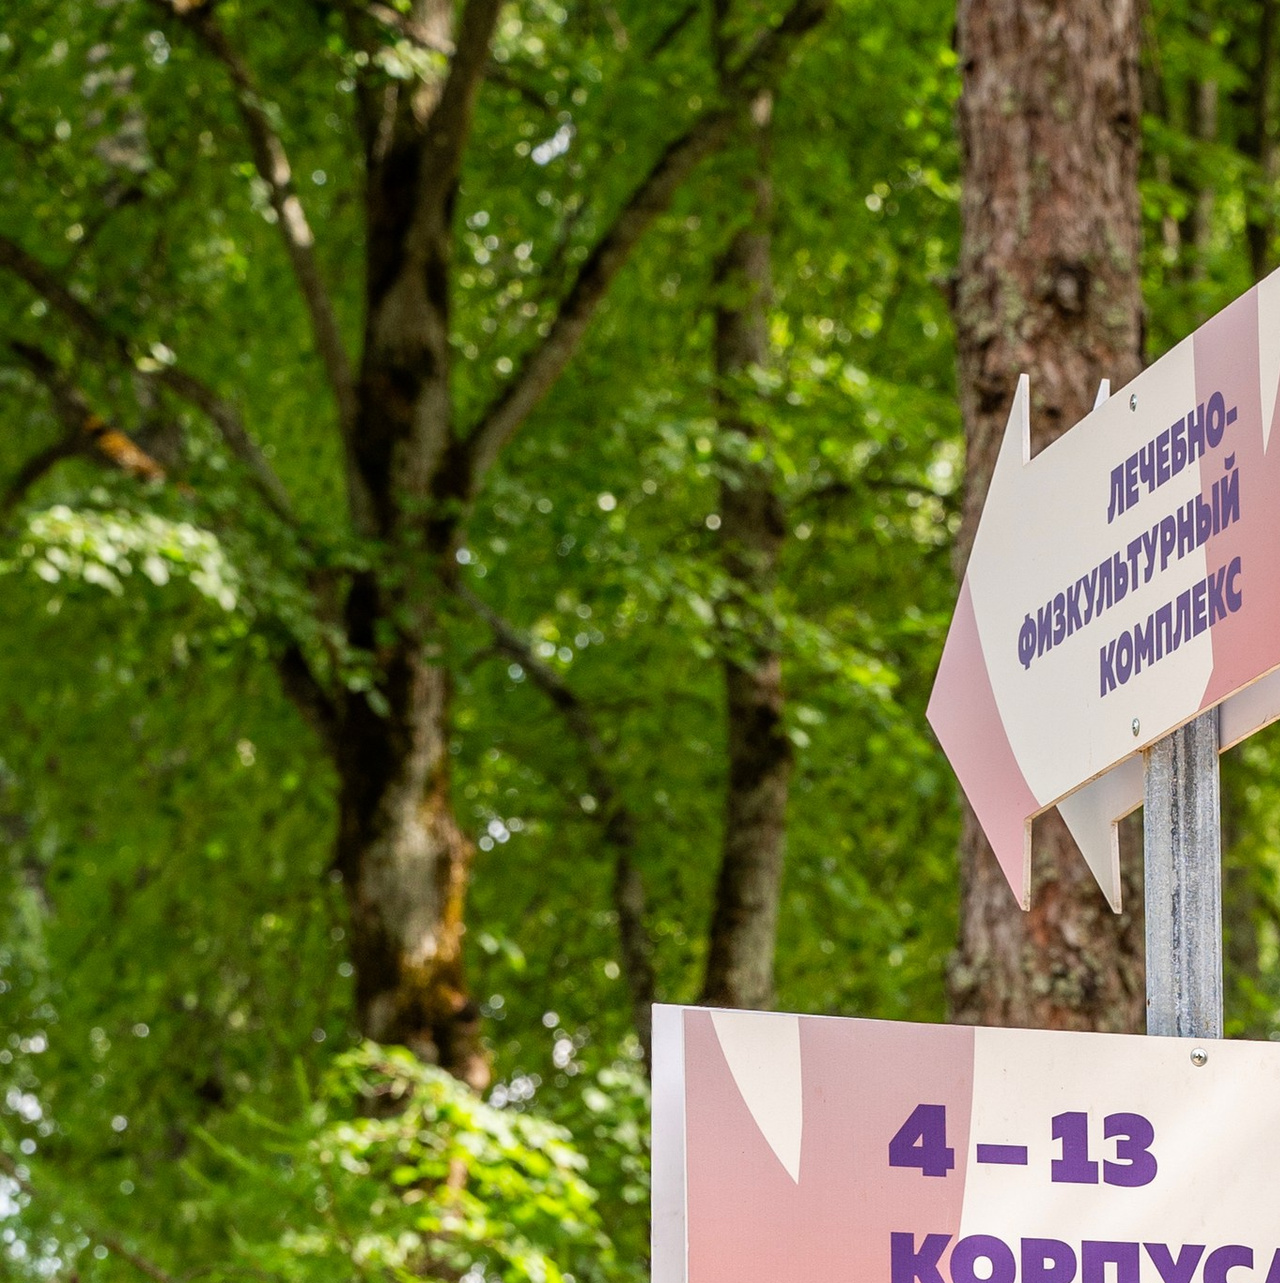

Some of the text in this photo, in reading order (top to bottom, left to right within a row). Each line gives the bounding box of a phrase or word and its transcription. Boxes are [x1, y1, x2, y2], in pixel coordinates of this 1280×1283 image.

[1107, 391, 1238, 524] ЛЕЧЕБНО-
[1018, 454, 1242, 671] ФИЗКУЛЬТУРНЫЙ
[1100, 556, 1243, 698] КОМПЛЕКС
[888, 1103, 955, 1178] 4
[1051, 1111, 1158, 1188] 13
